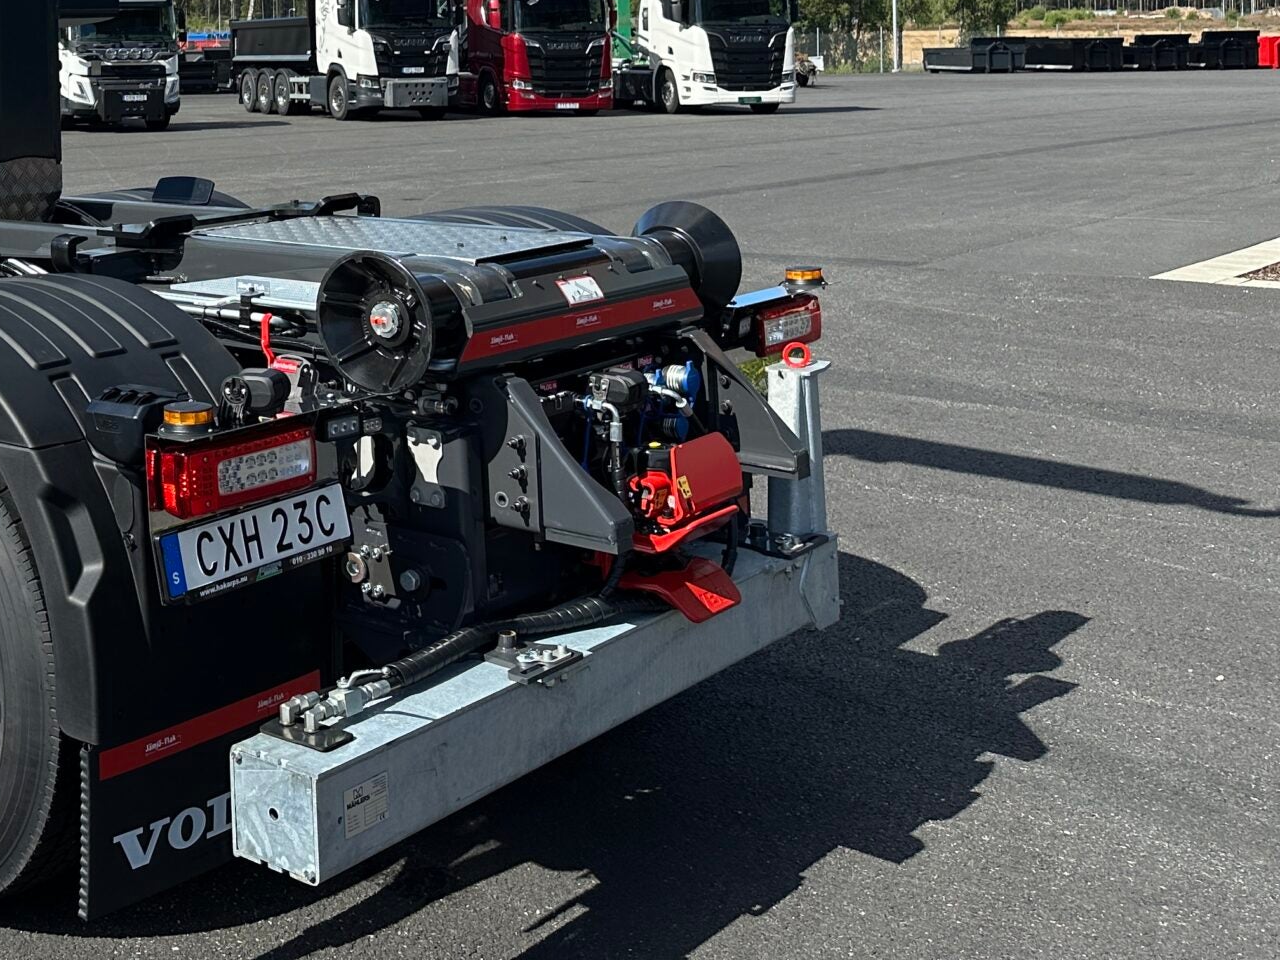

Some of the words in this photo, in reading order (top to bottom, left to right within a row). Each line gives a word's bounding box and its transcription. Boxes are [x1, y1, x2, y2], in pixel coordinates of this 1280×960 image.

[196, 515, 264, 577] CXH
[271, 494, 335, 554] 23C
[292, 555, 303, 566] 010
[325, 545, 333, 554] 10
[172, 572, 181, 585] S
[113, 791, 233, 870] VOL
